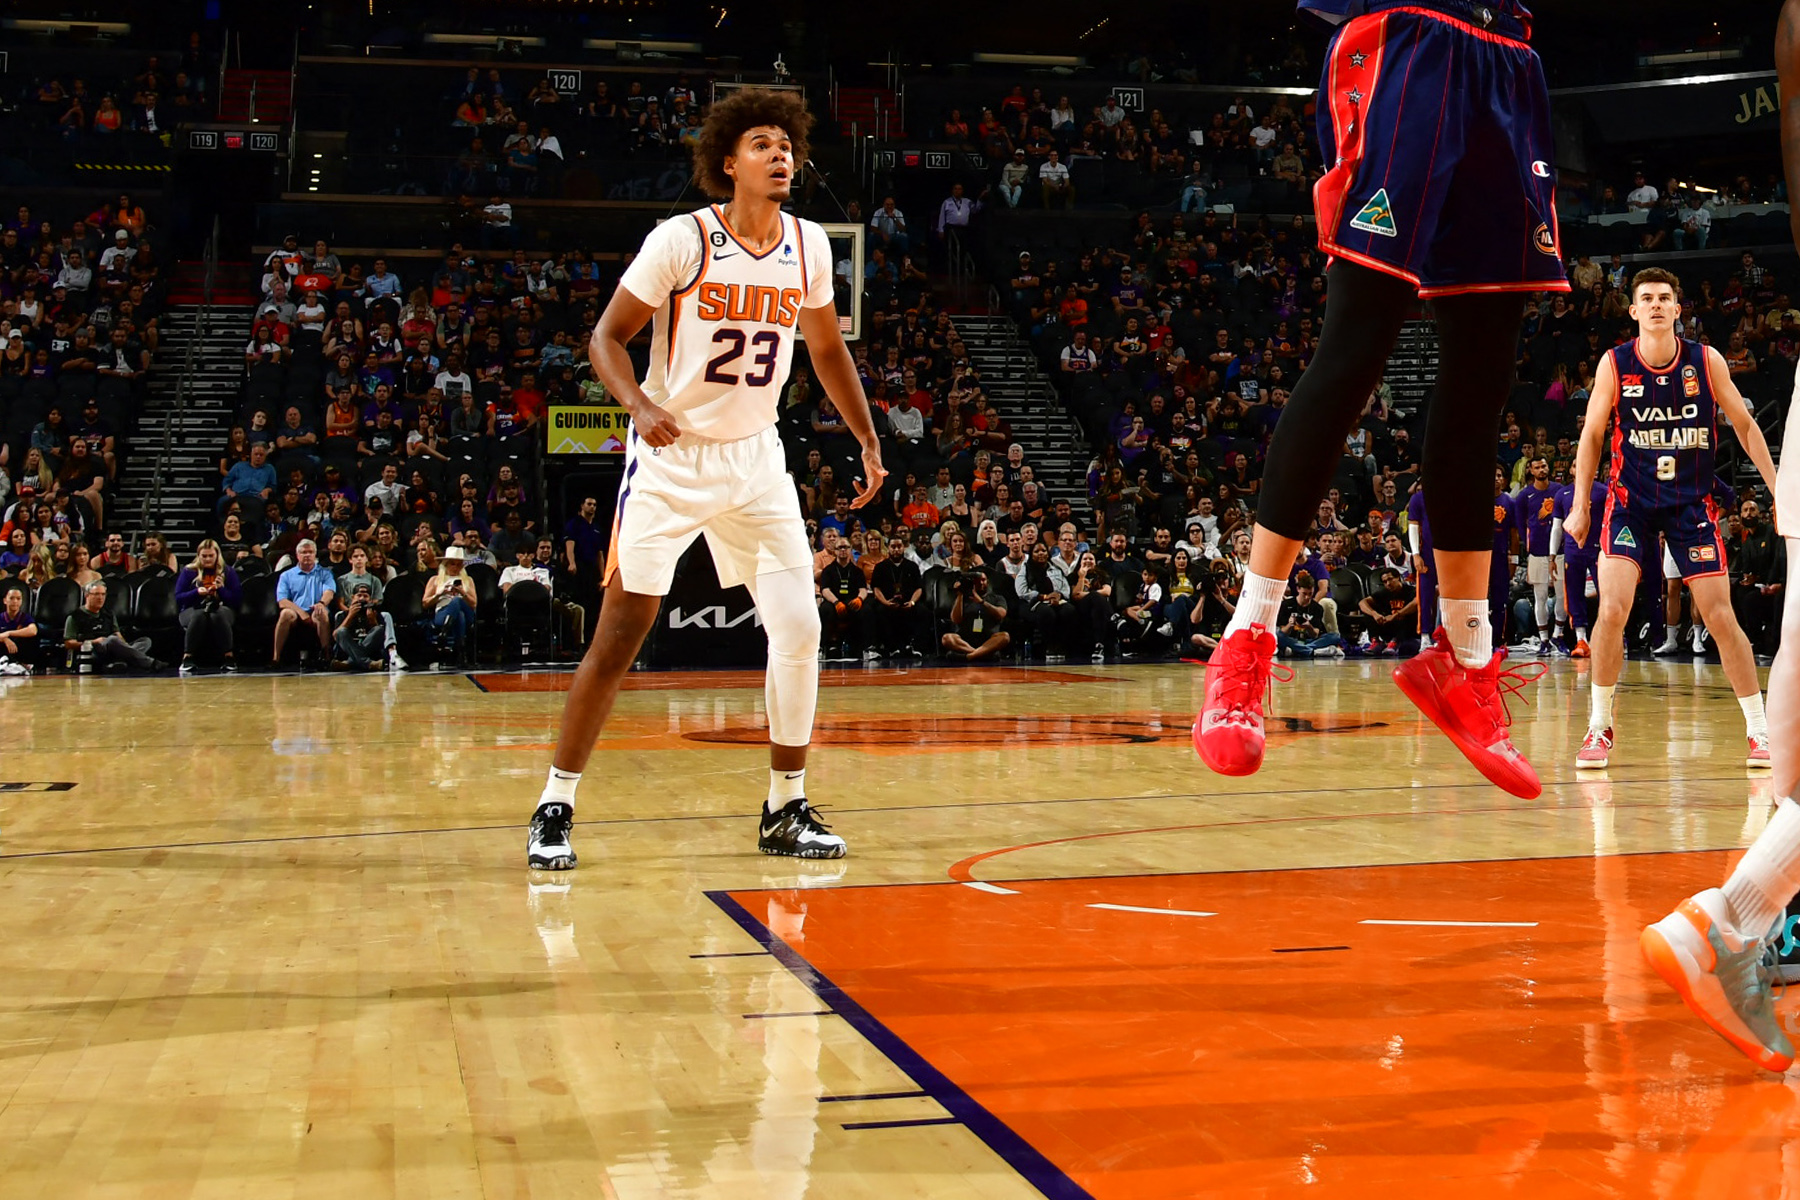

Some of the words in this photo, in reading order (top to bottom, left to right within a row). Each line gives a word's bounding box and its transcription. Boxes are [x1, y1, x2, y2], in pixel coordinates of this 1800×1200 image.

[553, 74, 576, 90] 120
[1118, 92, 1137, 107] 121
[194, 134, 213, 147] 119
[256, 136, 274, 148] 120
[930, 154, 946, 166] 121
[778, 257, 799, 267] PayPal
[698, 282, 802, 328] SUNS
[705, 328, 780, 387] 23
[1621, 374, 1644, 386] 2K
[1622, 384, 1645, 398] 23
[555, 412, 611, 429] GUIDING
[614, 412, 630, 429] YO
[1631, 403, 1699, 423] VALO
[1628, 426, 1710, 450] ADELAIDE
[1656, 455, 1676, 482] 9
